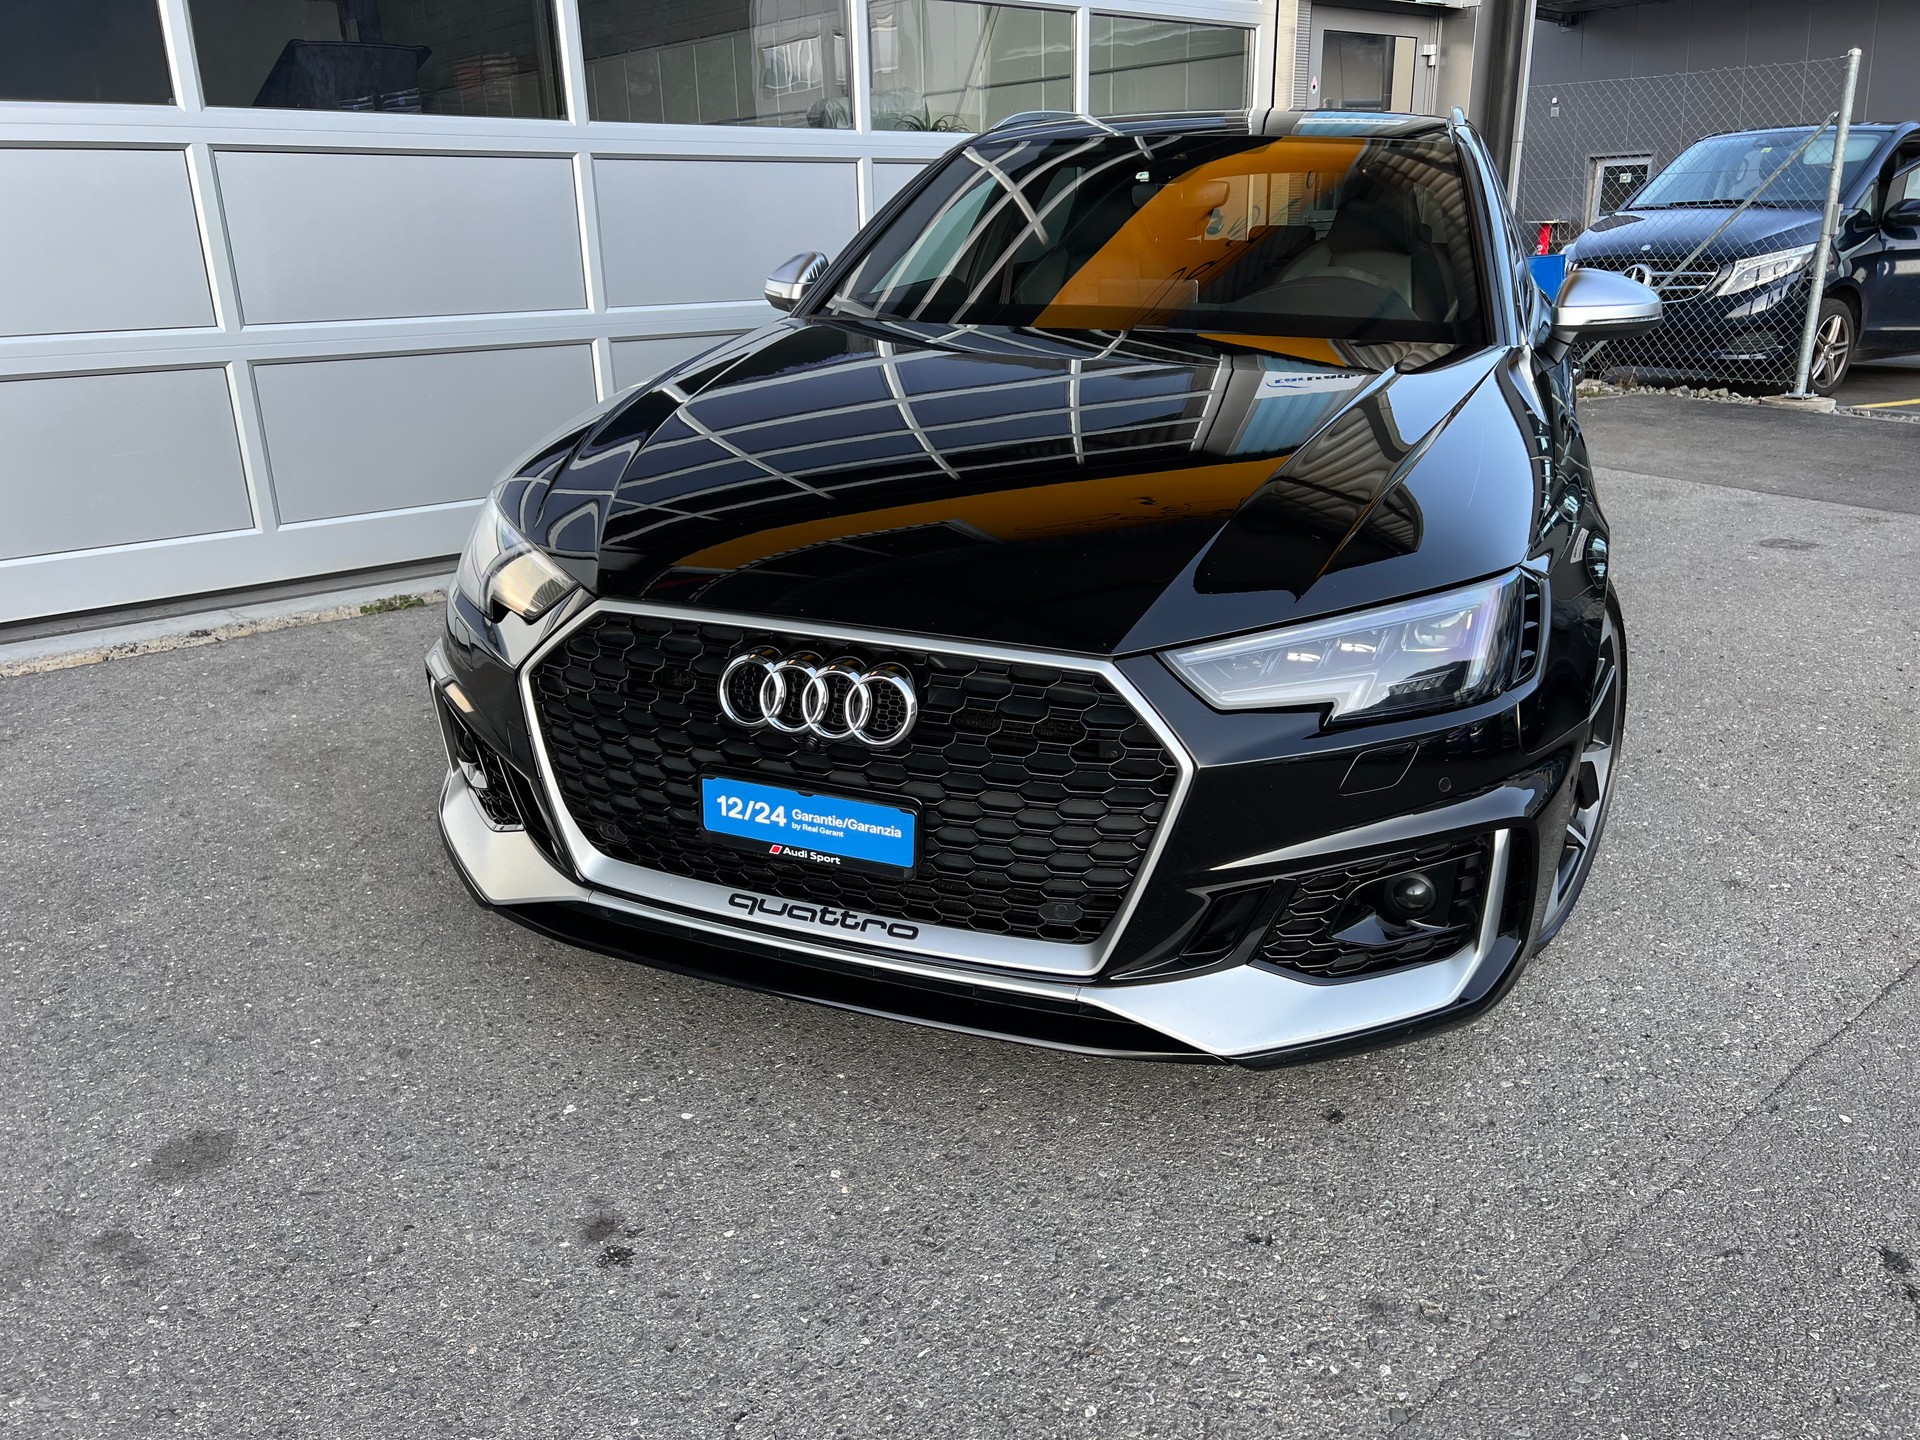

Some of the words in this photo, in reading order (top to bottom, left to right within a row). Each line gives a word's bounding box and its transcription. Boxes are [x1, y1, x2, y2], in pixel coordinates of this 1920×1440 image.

[716, 795, 787, 827] 12/24
[791, 808, 902, 838] Garantie/Garanzia
[791, 822, 801, 831] by
[802, 824, 818, 833] Real
[819, 827, 844, 838] Garant
[783, 847, 808, 859] Audi
[810, 852, 841, 865] Sport
[728, 893, 919, 941] quattro
